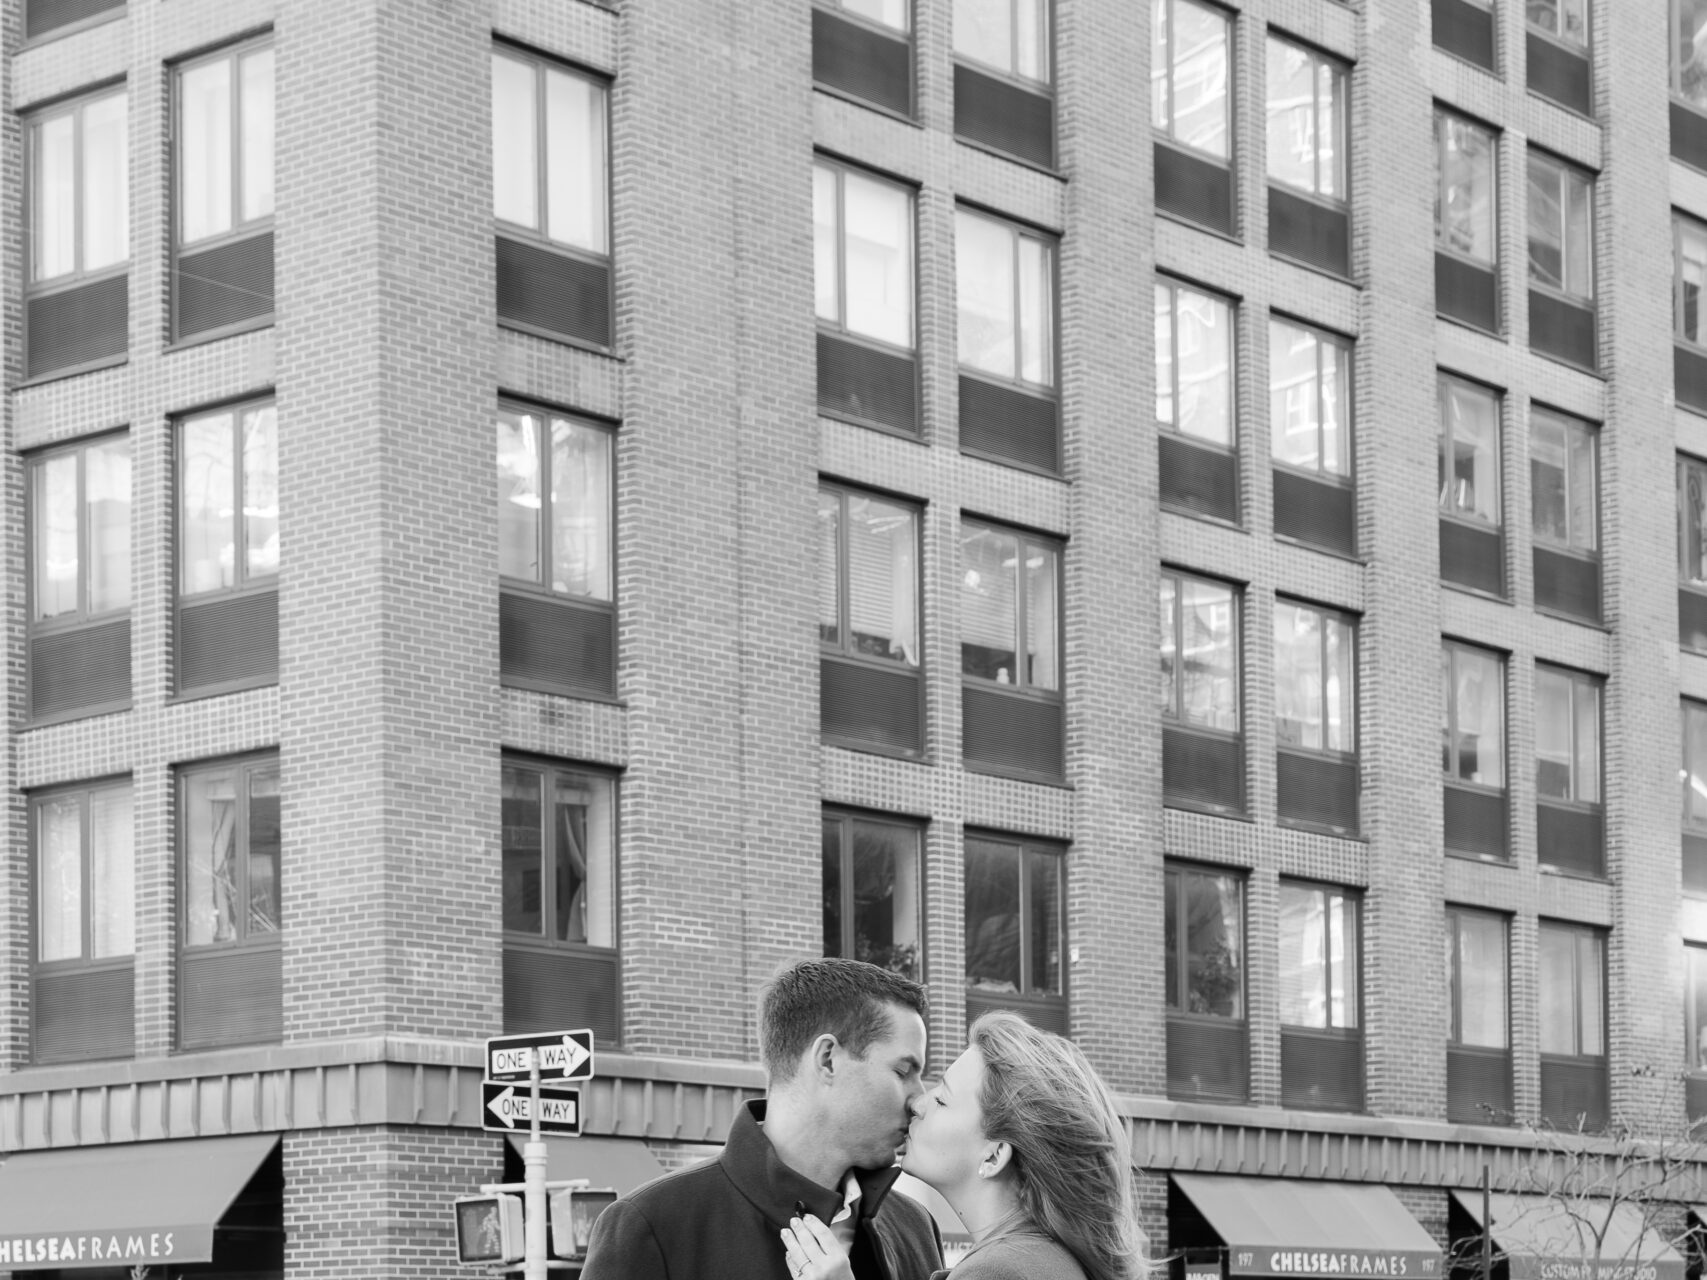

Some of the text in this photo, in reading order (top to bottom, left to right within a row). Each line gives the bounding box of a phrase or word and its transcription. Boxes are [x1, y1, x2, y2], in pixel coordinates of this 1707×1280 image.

[496, 1047, 577, 1070] ONE WAY
[502, 1098, 570, 1120] ONE WAY
[0, 1232, 174, 1264] HELSEAFRAMES
[1238, 1251, 1436, 1276] 197 CHELSEAFRAMES 197
[1541, 1263, 1580, 1280] CUSTOM
[1581, 1265, 1622, 1280] FRMIG
